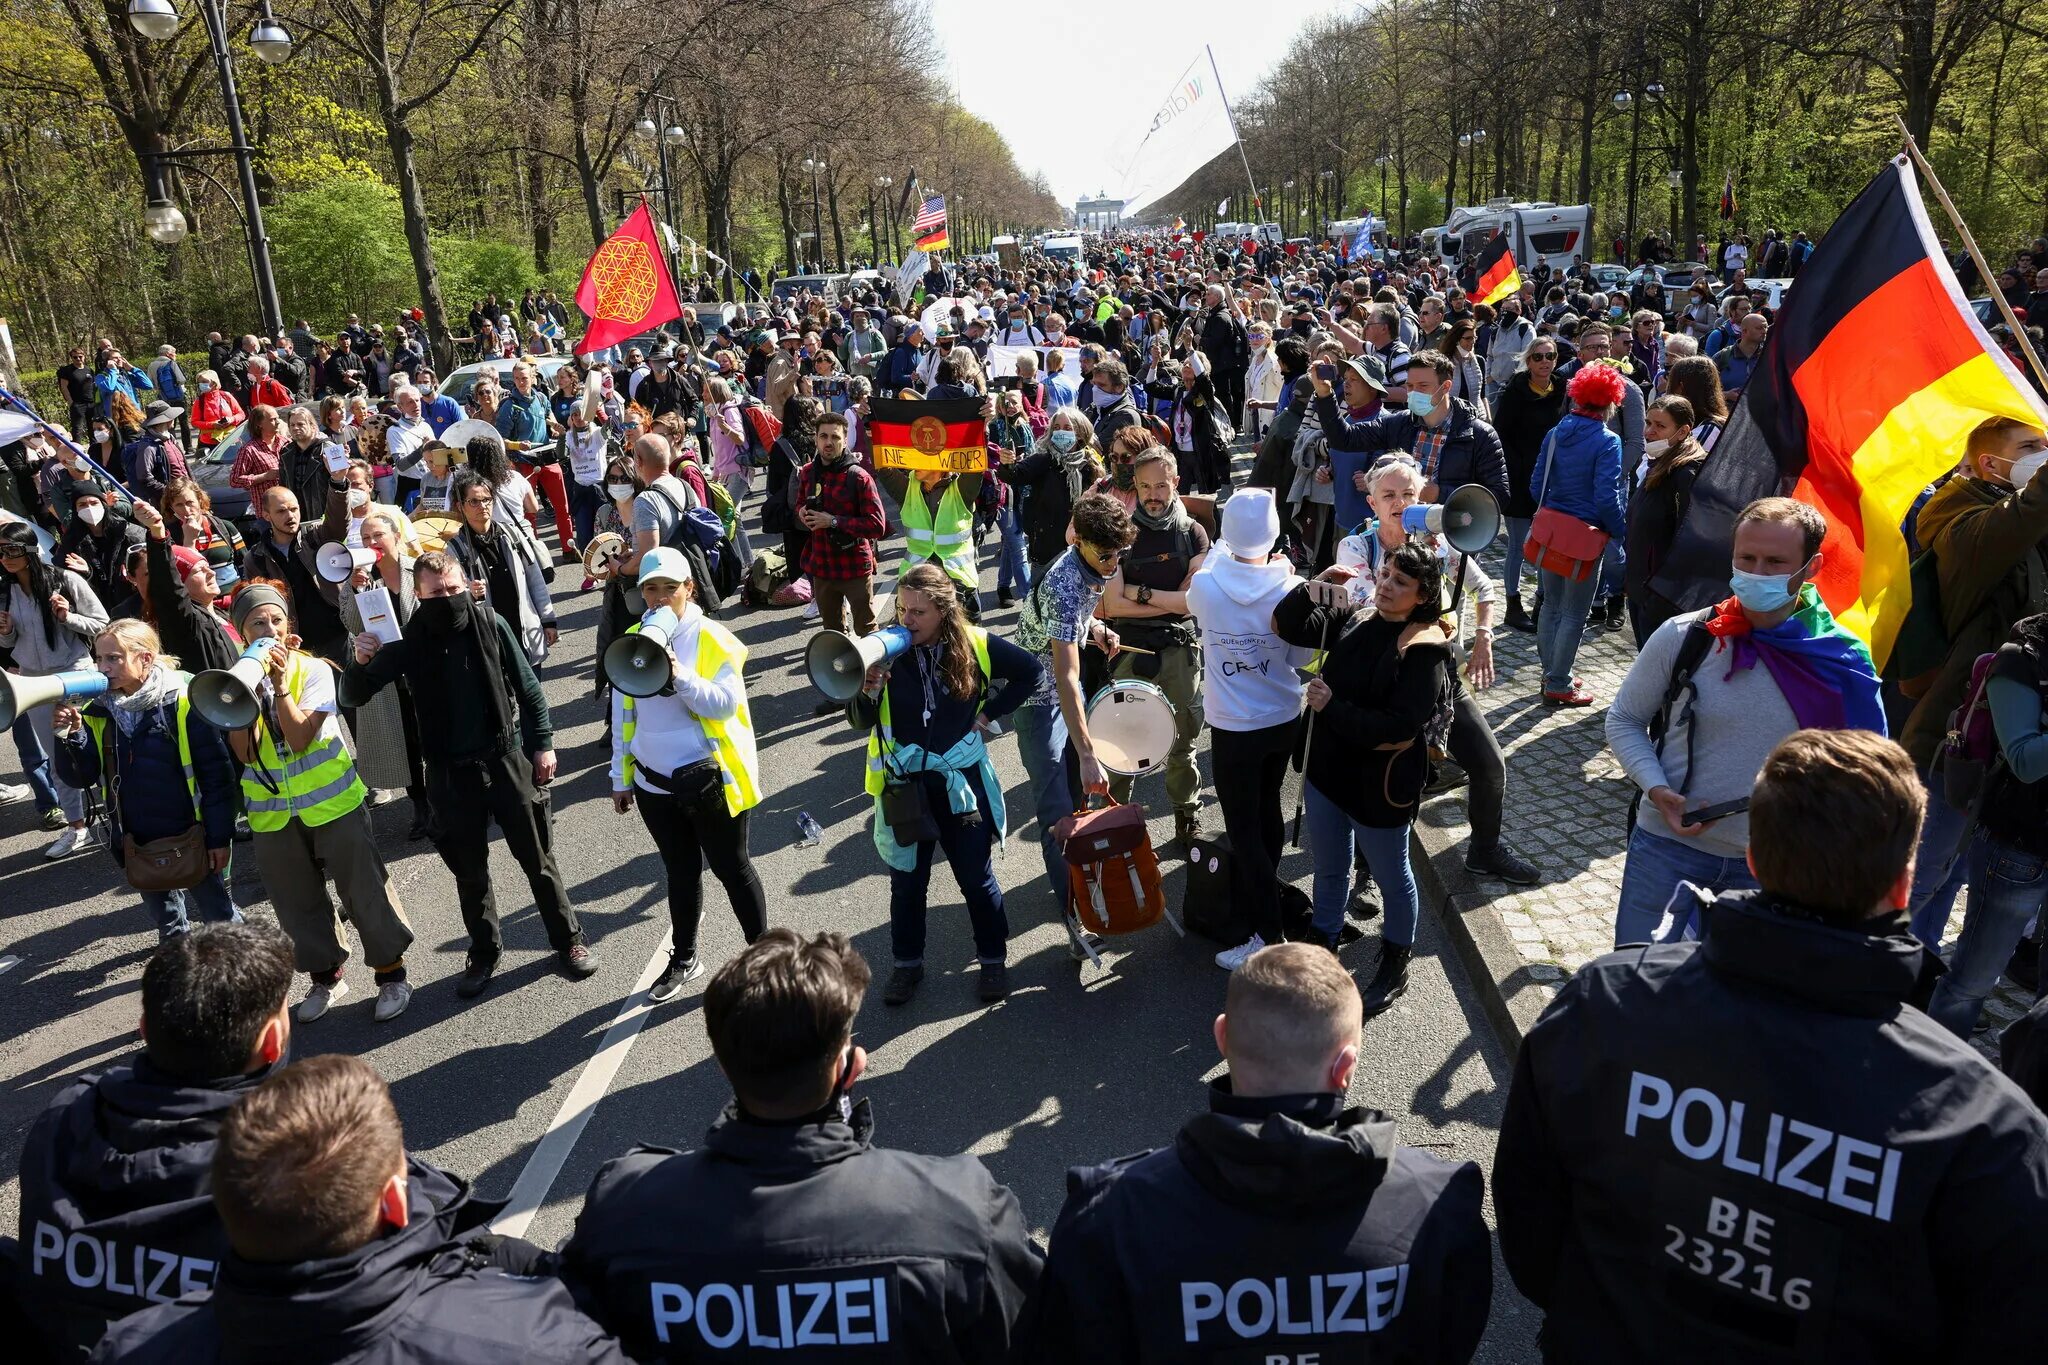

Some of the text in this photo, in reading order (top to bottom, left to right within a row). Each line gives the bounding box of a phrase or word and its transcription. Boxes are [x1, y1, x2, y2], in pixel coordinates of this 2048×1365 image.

[884, 448, 983, 470] NIE WIEDER
[1220, 638, 1267, 646] QUERDENKEN
[1625, 1070, 1902, 1222] POLIZEI
[1706, 1196, 1775, 1256] BE
[1180, 1263, 1410, 1342] POLIZEI
[1664, 1223, 1813, 1311] 23216
[650, 1277, 890, 1349] POLIZEI
